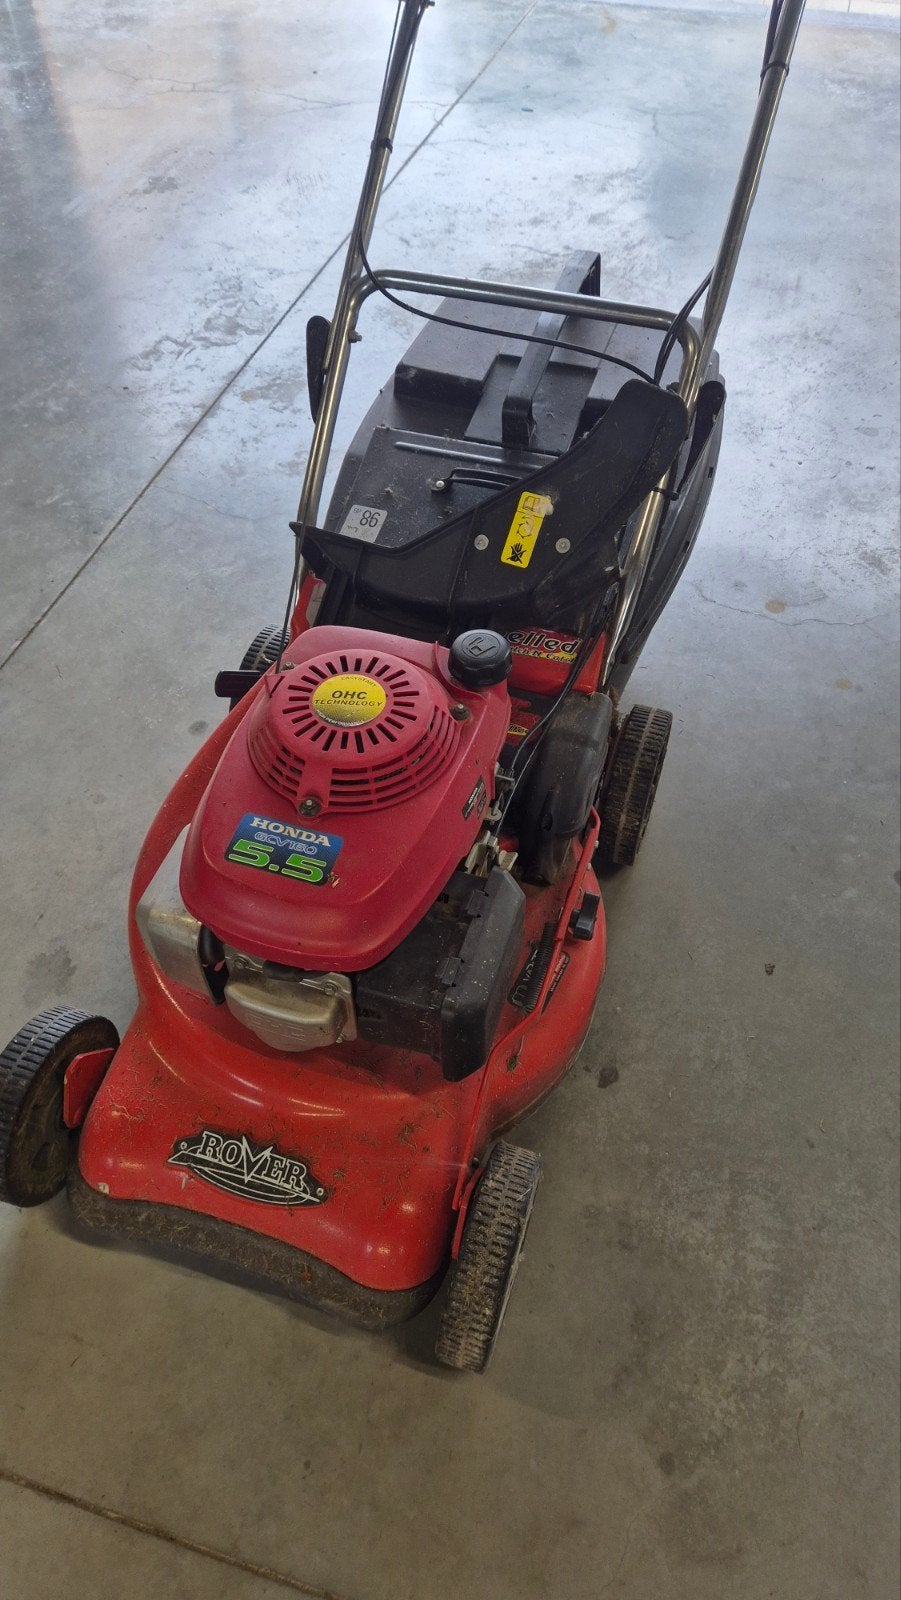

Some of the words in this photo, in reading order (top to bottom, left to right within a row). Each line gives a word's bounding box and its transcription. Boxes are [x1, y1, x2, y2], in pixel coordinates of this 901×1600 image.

[506, 630, 583, 655] elled
[314, 699, 384, 707] TECHNOLOGY
[331, 690, 368, 700] OHC
[250, 816, 331, 847] HONDA
[228, 838, 327, 883] 5.5
[196, 1131, 308, 1191] ROVER
